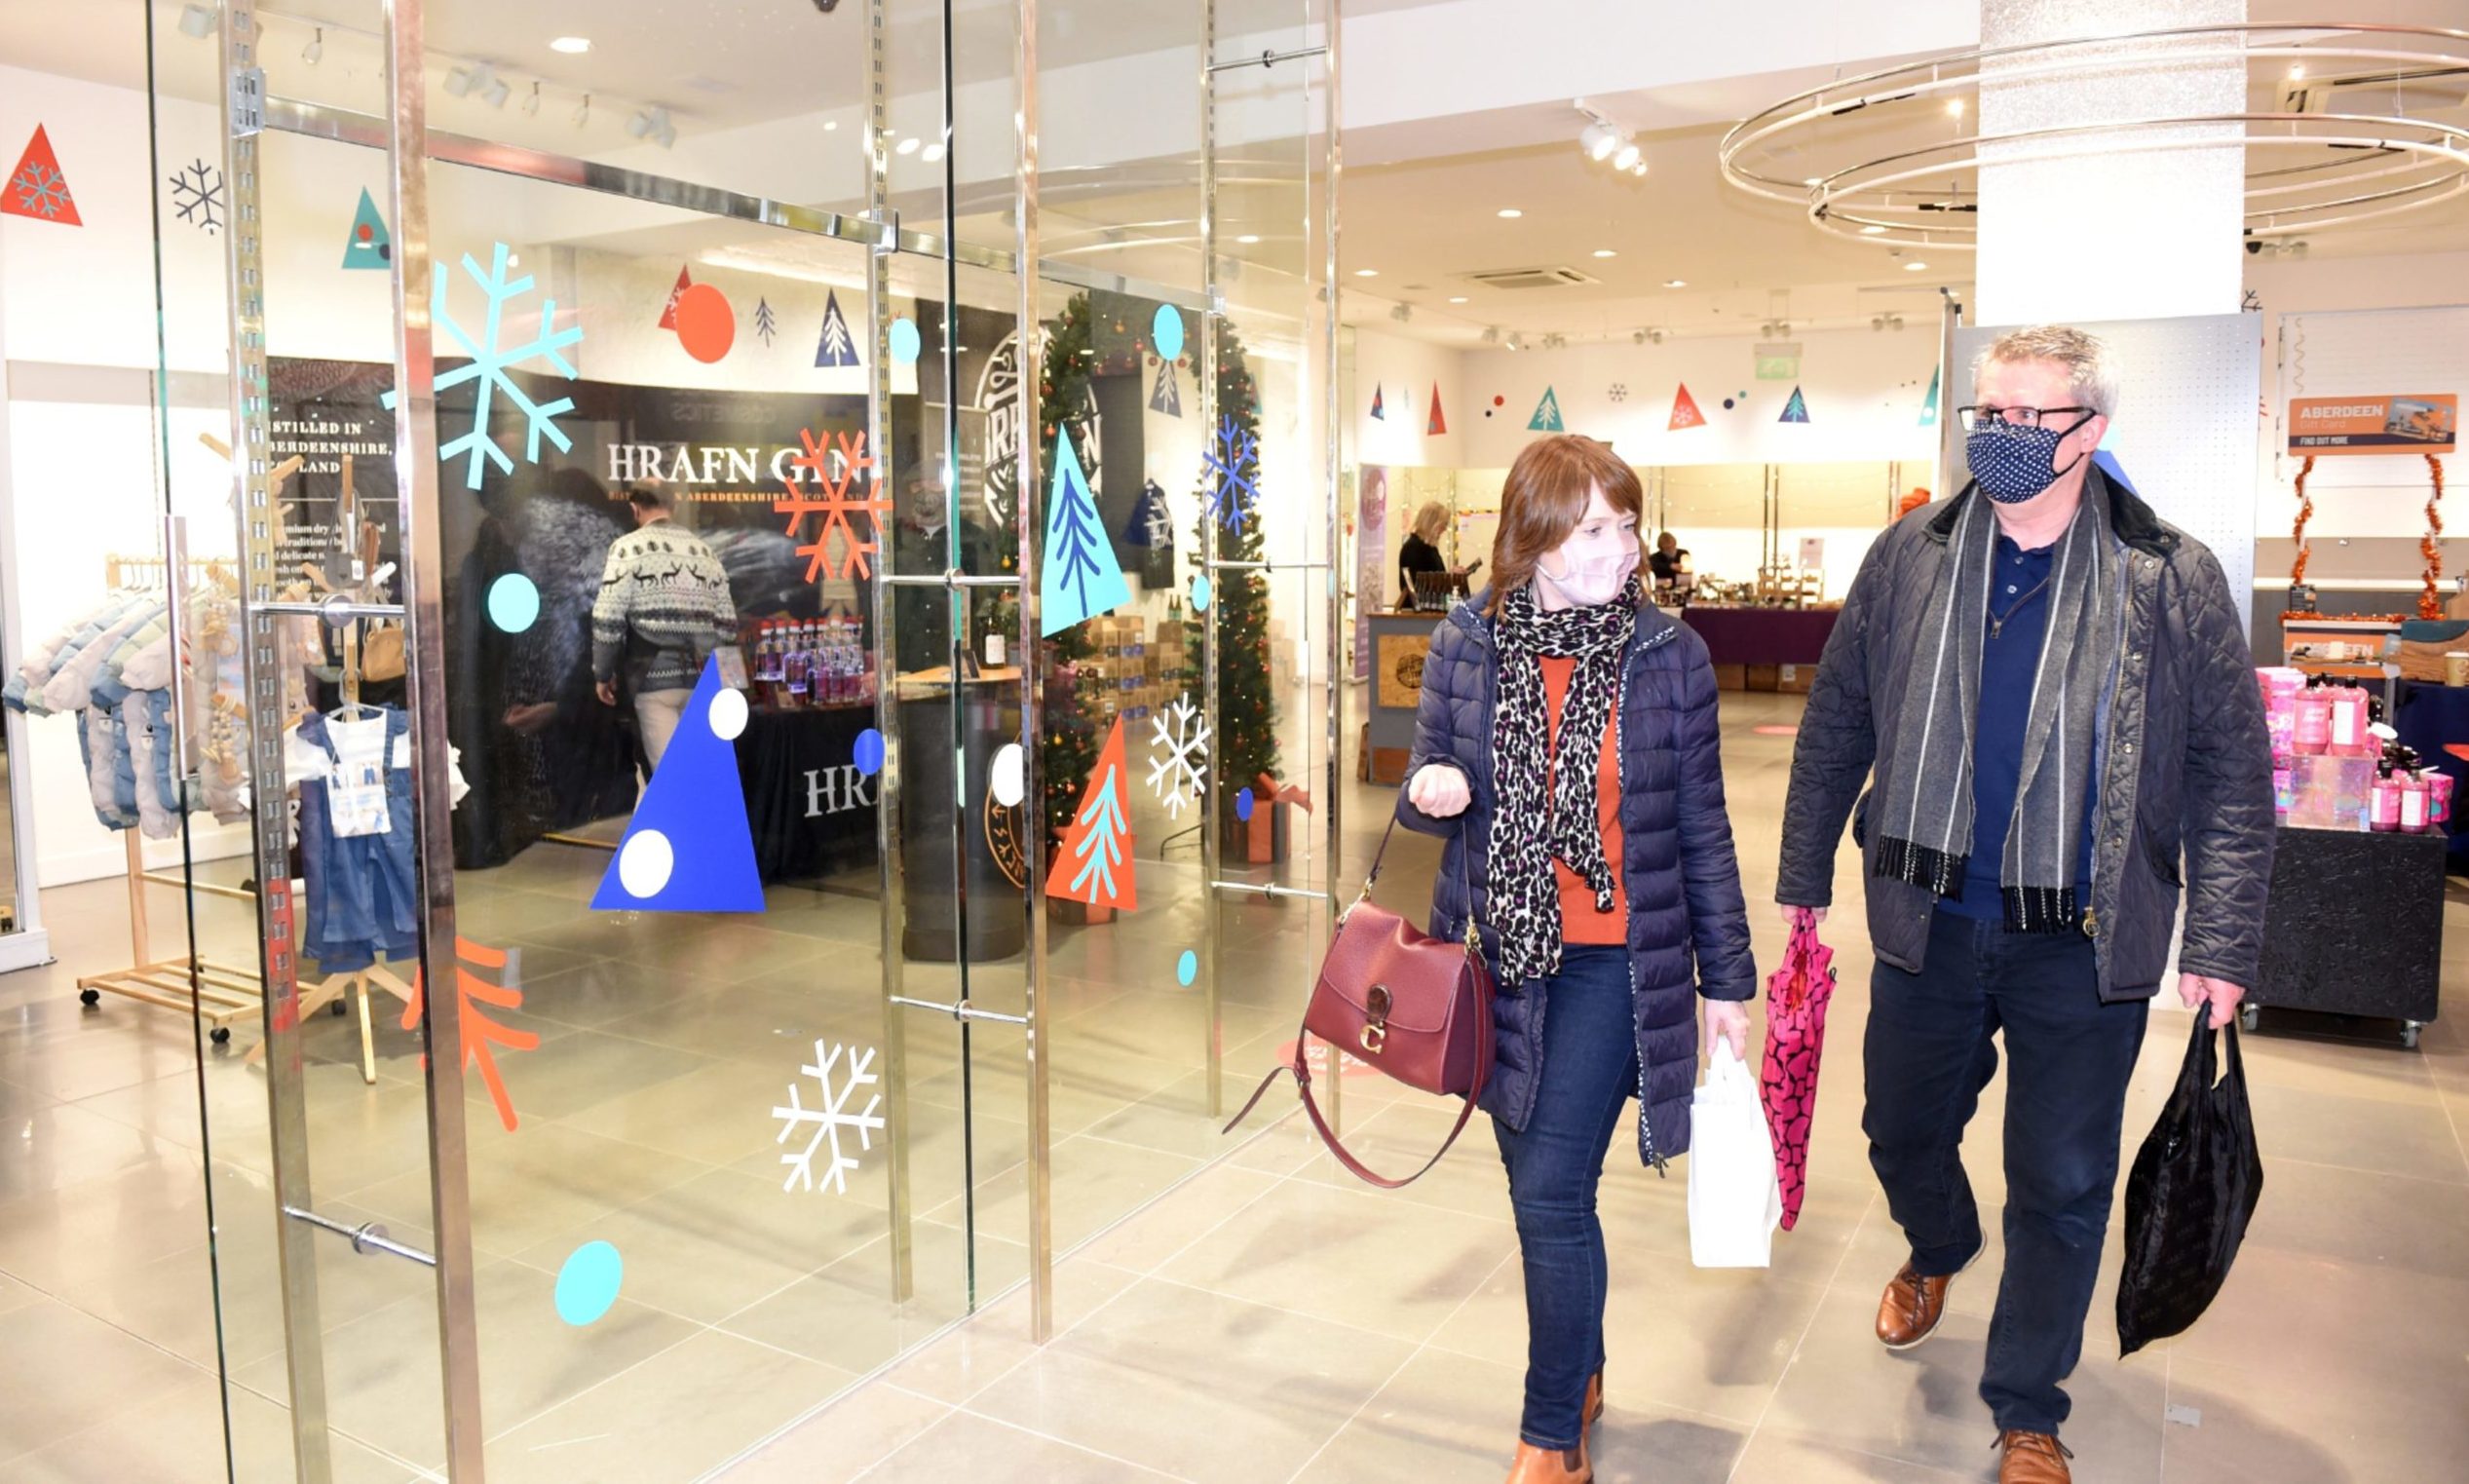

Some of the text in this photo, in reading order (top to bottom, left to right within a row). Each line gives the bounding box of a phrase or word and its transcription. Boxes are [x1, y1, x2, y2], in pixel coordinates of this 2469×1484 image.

[2300, 404, 2383, 418] ABERDEEN
[269, 420, 361, 436] STILLED IN
[2321, 419, 2346, 429] Card
[270, 440, 393, 456] BERDEENSHIRE,
[2299, 436, 2348, 446] FIND OUT MORE
[607, 443, 759, 483] HRAFN
